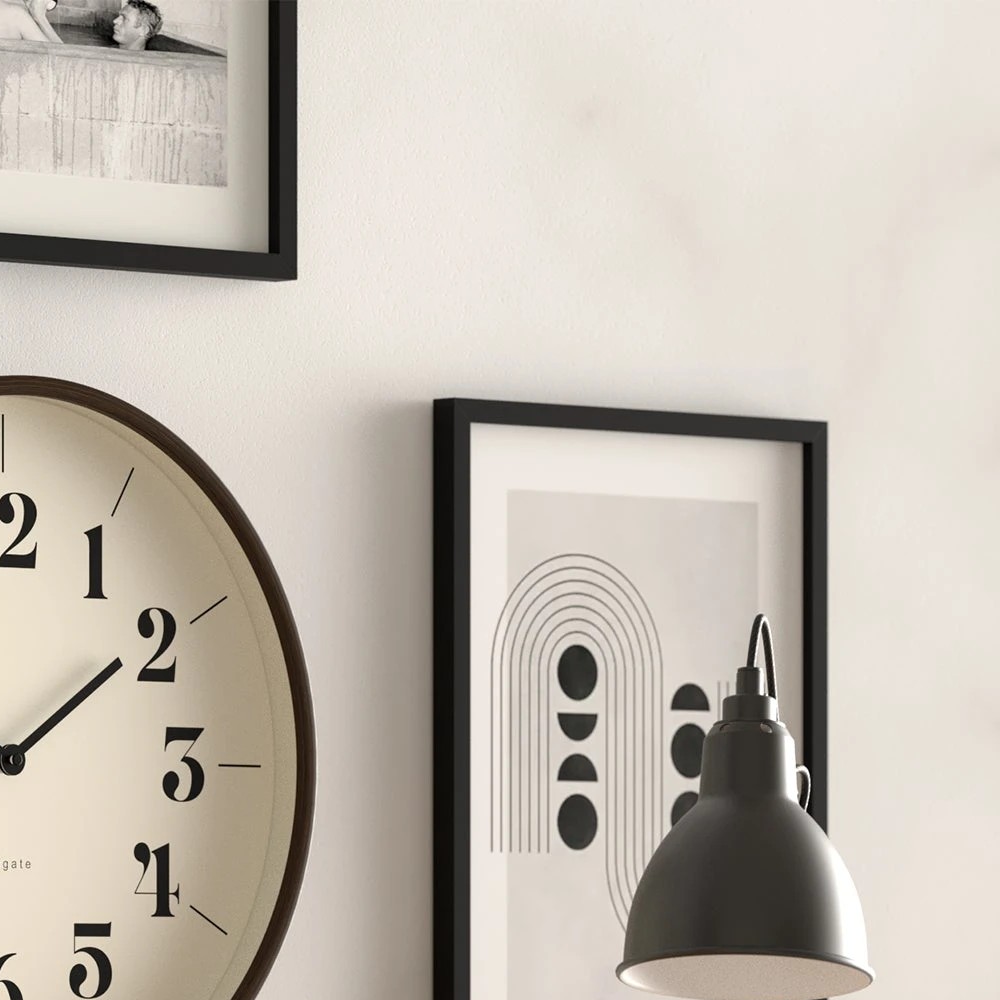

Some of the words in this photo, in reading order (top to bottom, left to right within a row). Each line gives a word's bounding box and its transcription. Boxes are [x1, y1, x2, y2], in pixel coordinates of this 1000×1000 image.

[83, 524, 108, 600] 1
[136, 607, 177, 683] 2
[161, 726, 205, 803] 3
[133, 842, 181, 918] 4
[68, 921, 113, 1000] 5
